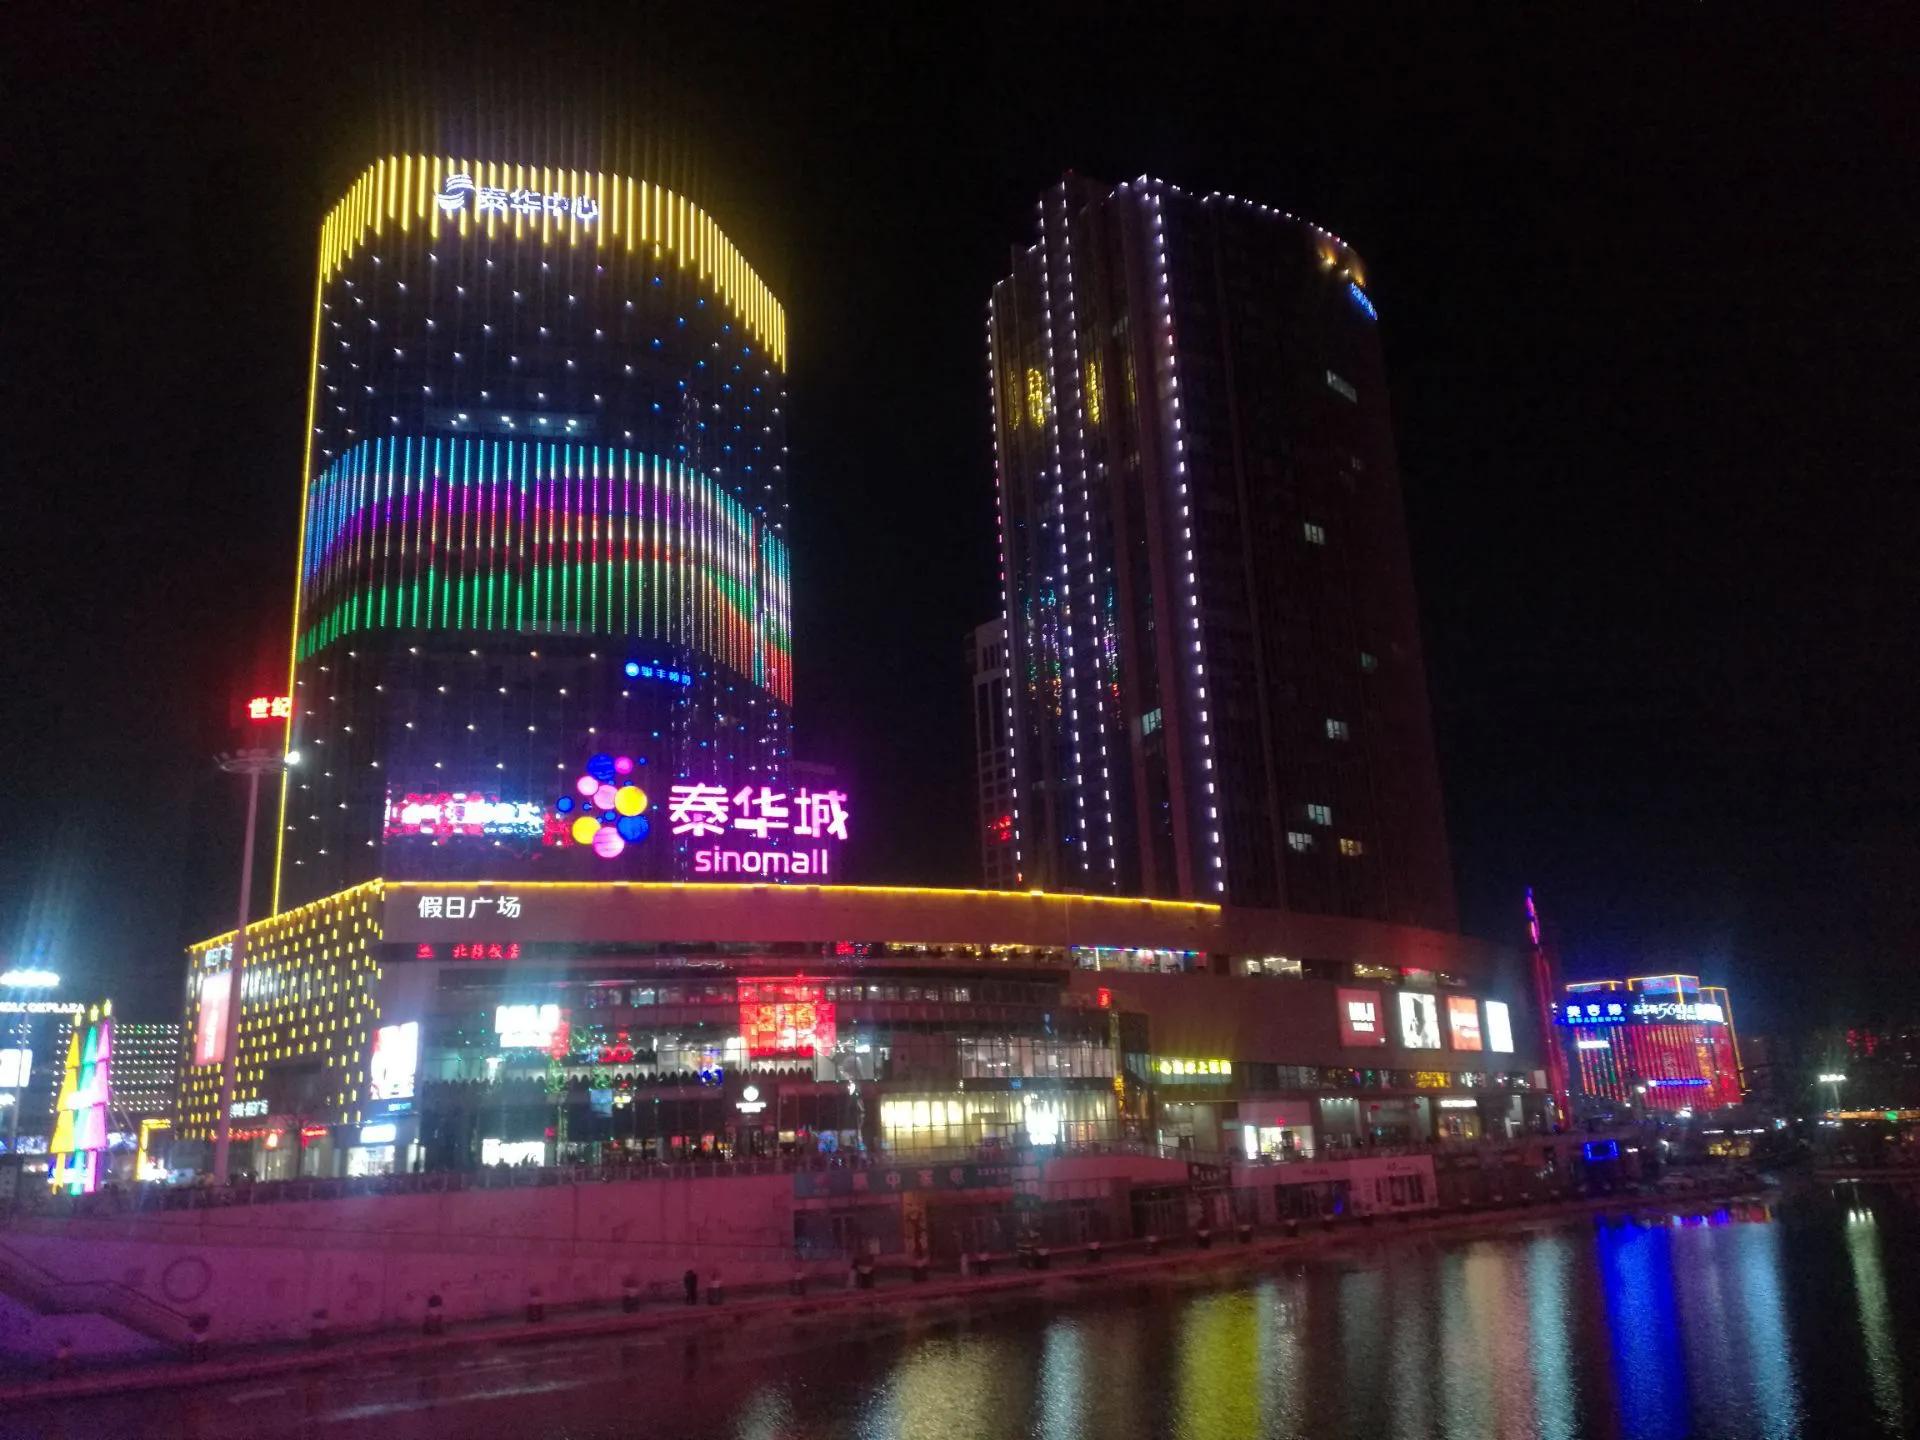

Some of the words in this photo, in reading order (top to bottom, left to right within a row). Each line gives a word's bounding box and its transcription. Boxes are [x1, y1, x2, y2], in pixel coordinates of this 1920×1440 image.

[668, 782, 849, 840] 泰华城
[694, 845, 828, 874] sinomall
[418, 895, 521, 919] 假日广场
